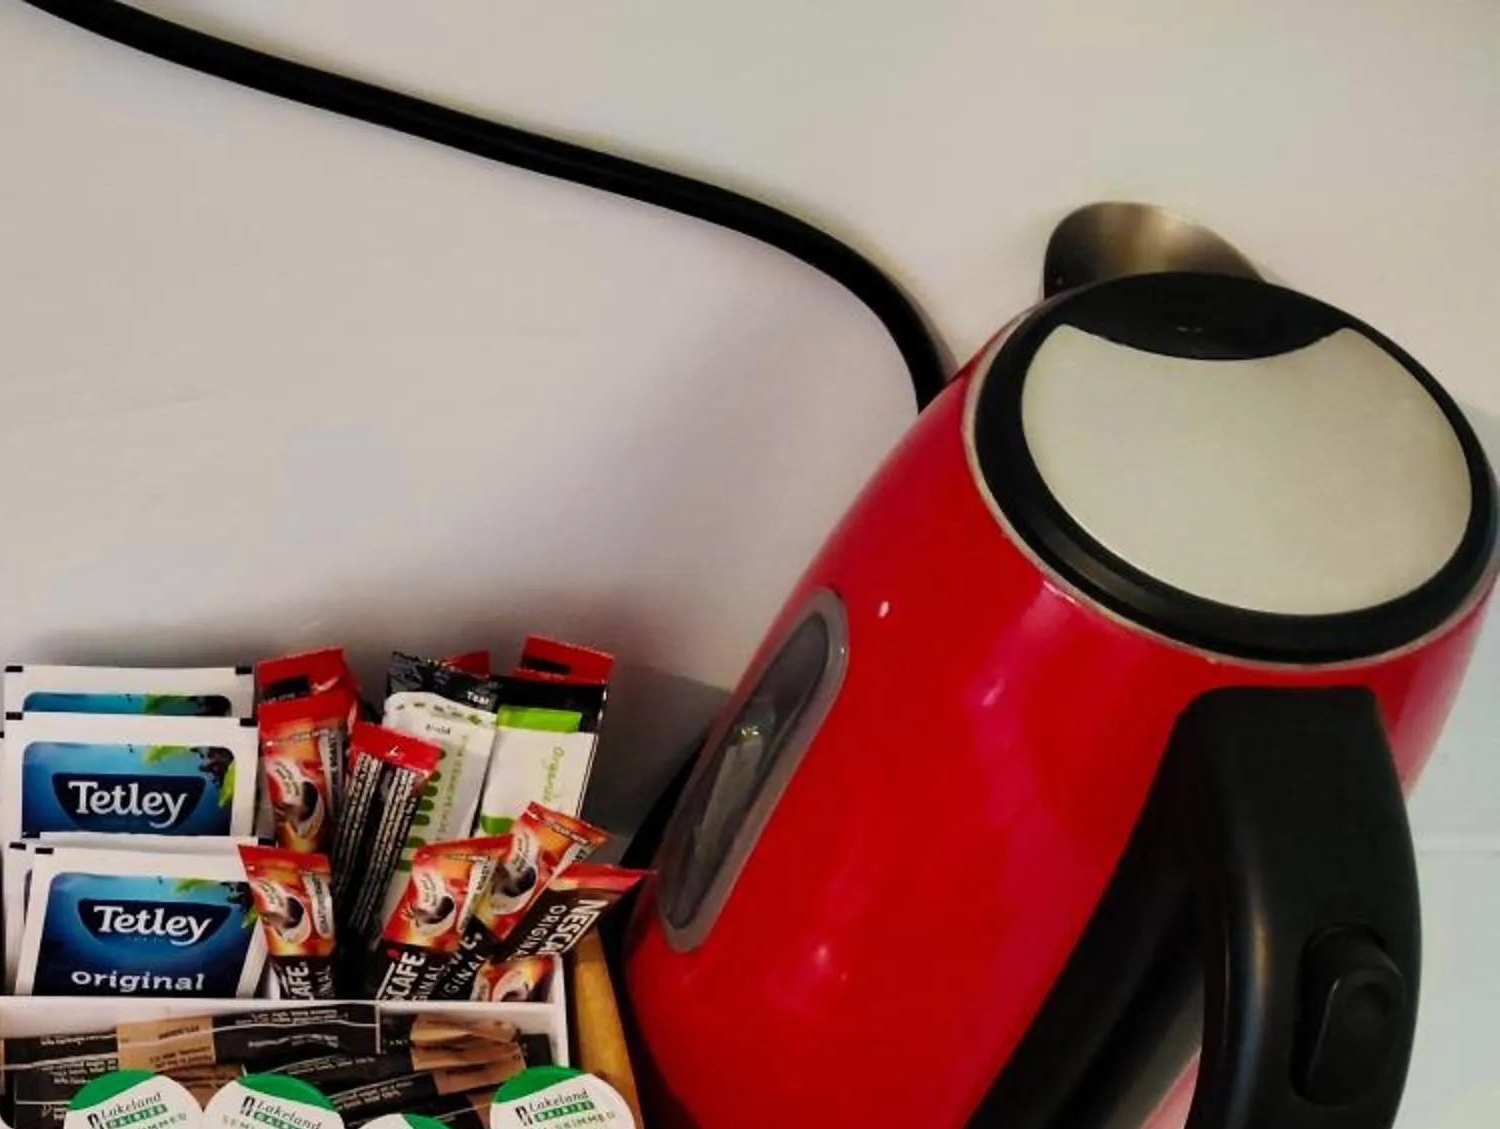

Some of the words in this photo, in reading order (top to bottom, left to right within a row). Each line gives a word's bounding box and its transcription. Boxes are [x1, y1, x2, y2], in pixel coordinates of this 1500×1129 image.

[67, 780, 188, 828] Tetley
[93, 904, 213, 947] Tetley
[537, 899, 609, 955] NESCA
[71, 970, 205, 993] original
[100, 1091, 164, 1119] Lakeland
[528, 1088, 590, 1114] Lakeland
